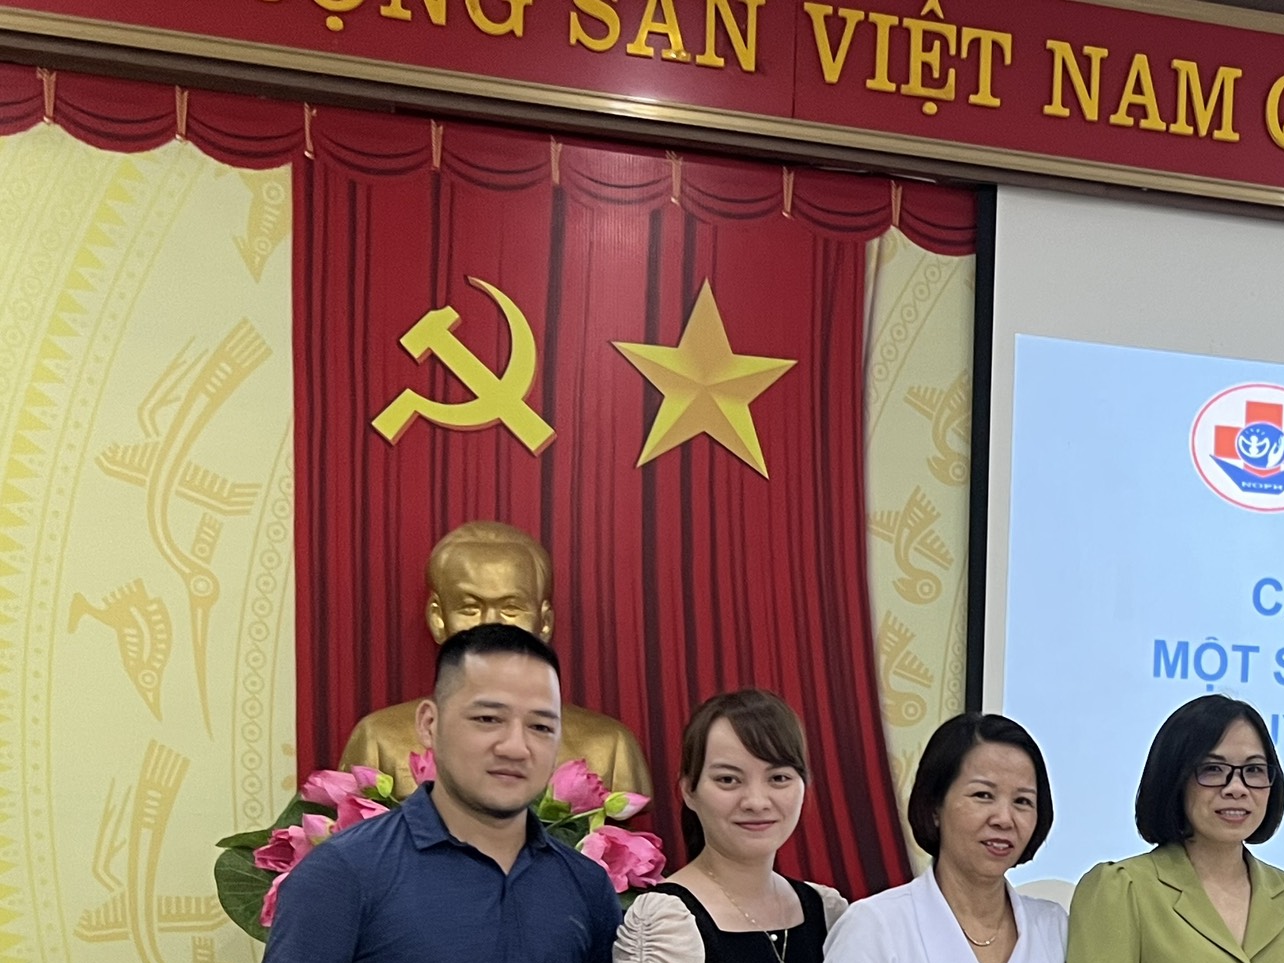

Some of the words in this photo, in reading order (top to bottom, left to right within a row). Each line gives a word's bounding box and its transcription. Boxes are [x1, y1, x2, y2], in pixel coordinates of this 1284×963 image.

[802, 0, 1012, 116] VIỆT
[1043, 40, 1243, 143] NAM
[1153, 636, 1260, 692] MỘT
